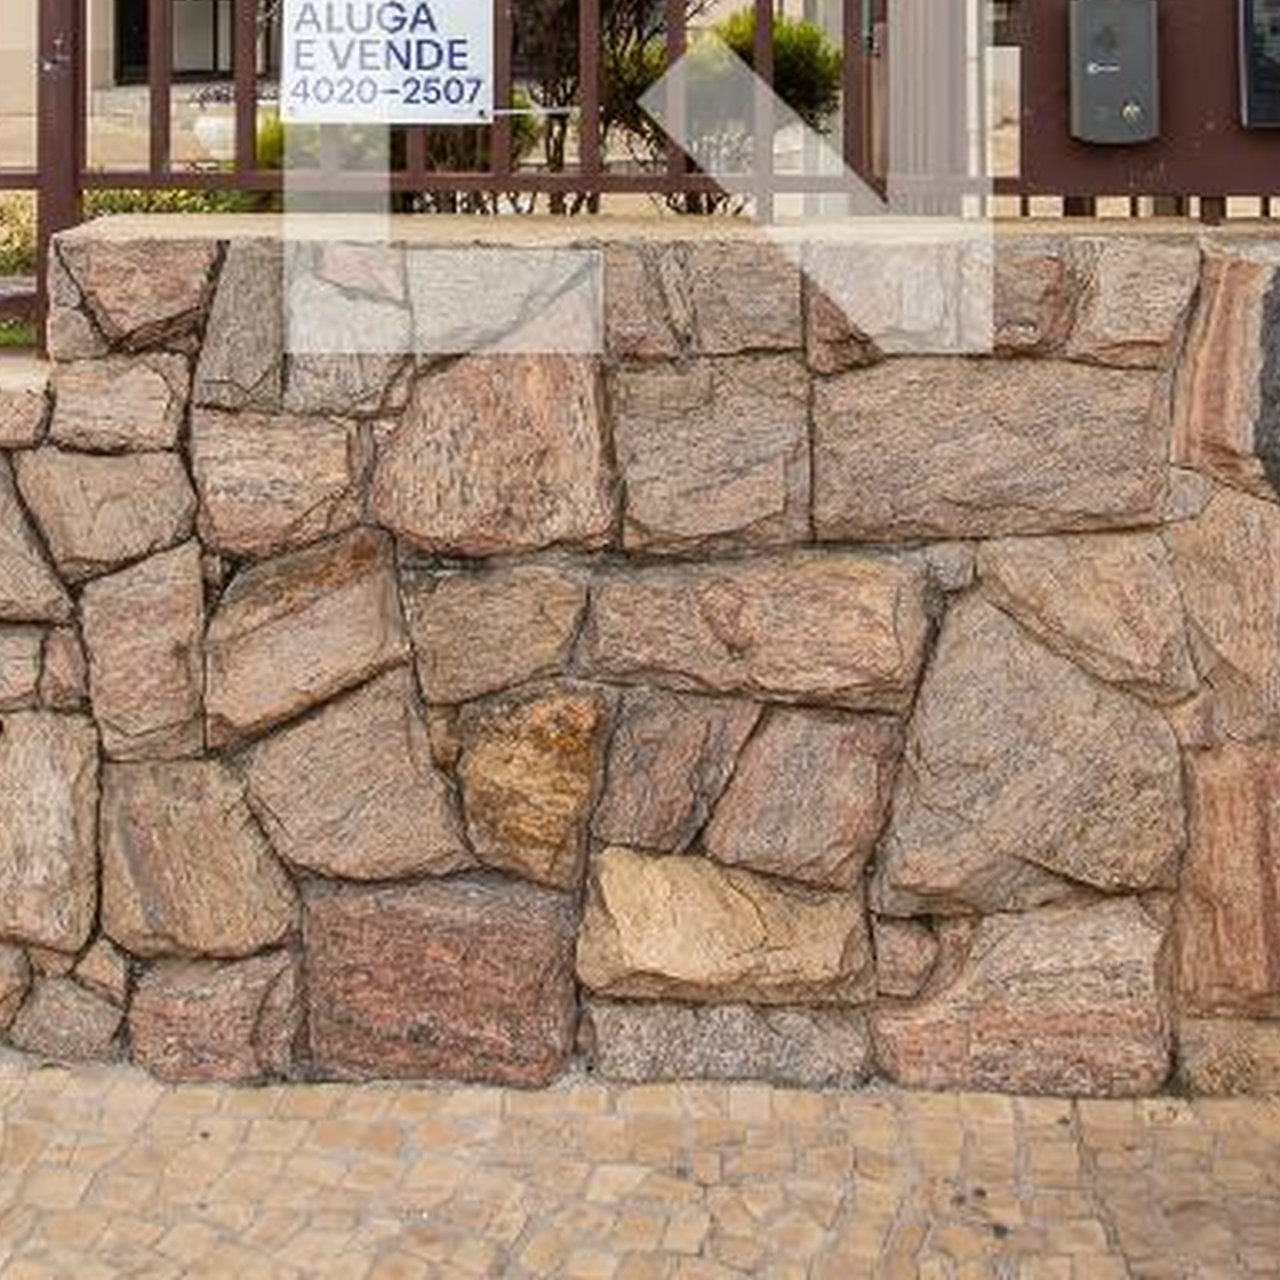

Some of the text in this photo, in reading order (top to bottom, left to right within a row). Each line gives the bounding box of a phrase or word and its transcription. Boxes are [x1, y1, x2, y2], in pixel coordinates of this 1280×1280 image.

[294, 1, 437, 35] ALUGA
[296, 39, 469, 71] E VENDE
[290, 77, 483, 106] 4020-2507
